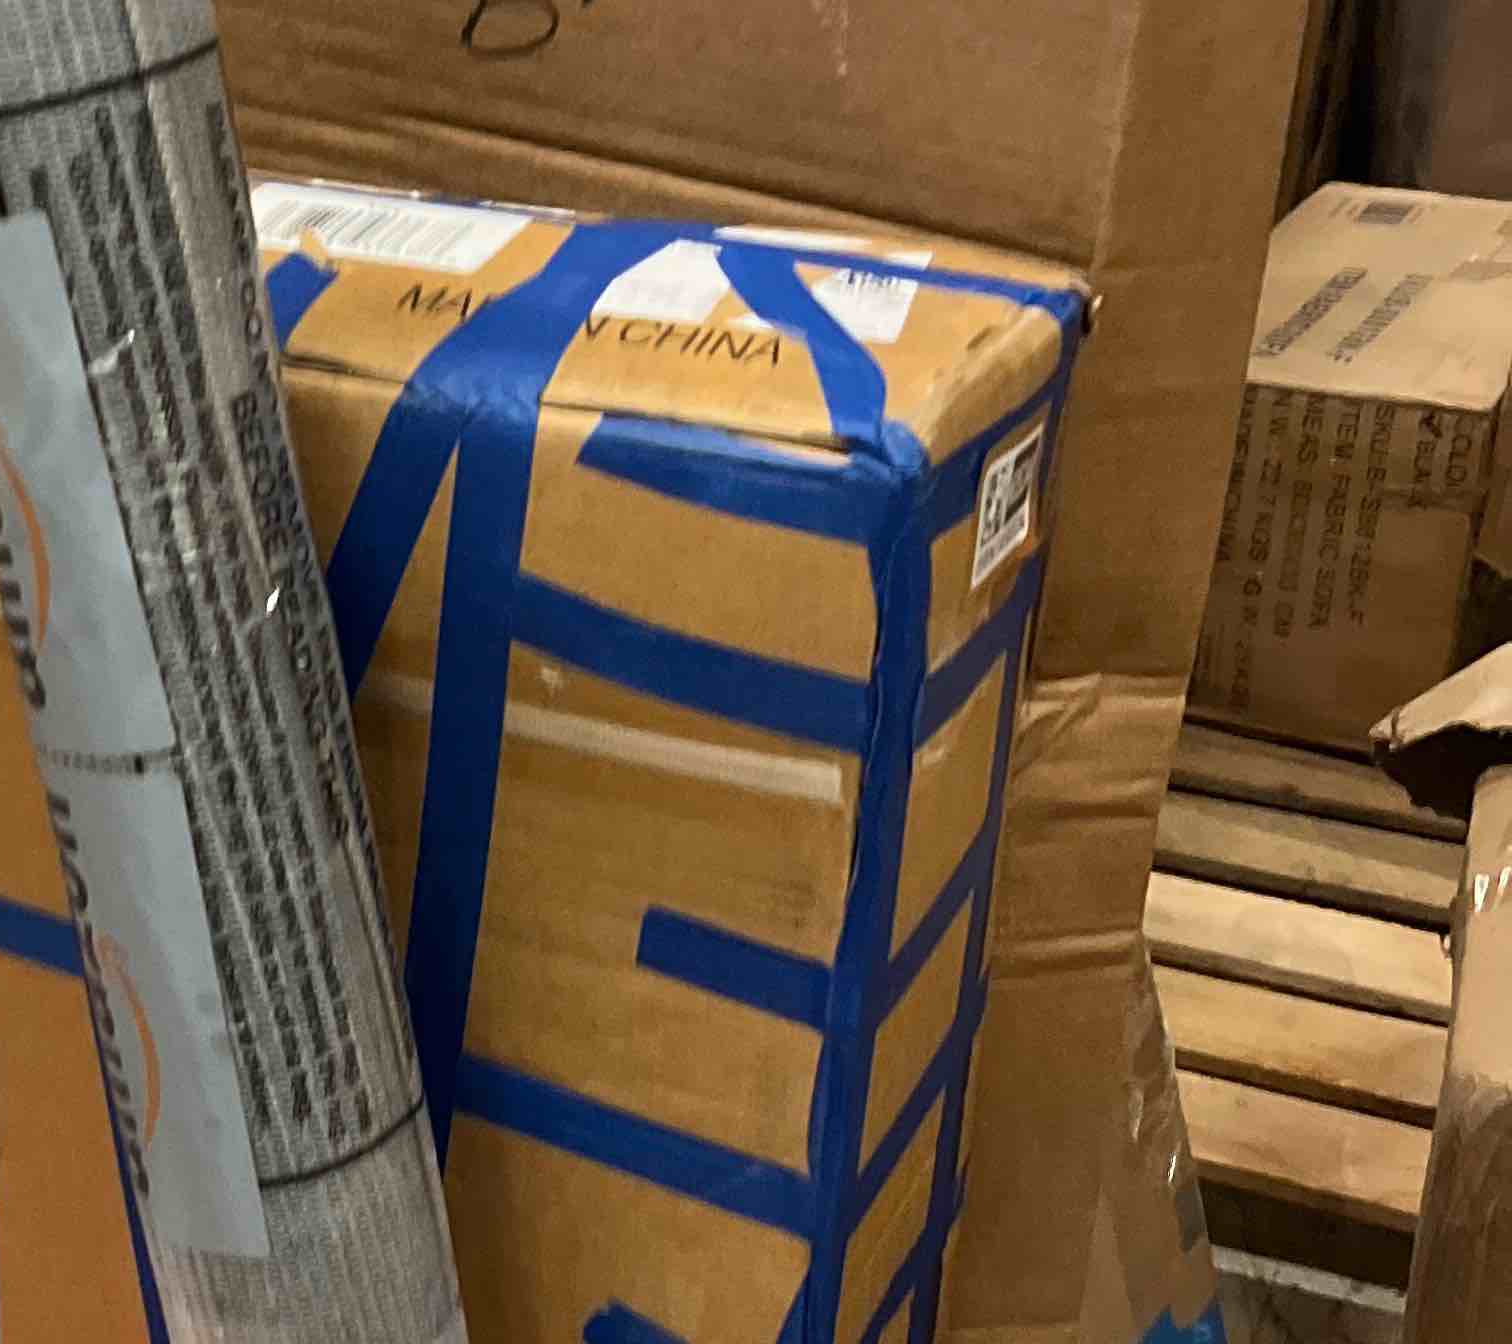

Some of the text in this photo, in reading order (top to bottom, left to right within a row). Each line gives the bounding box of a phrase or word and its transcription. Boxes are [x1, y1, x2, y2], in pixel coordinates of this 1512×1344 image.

[616, 318, 788, 368] CHINA
[229, 390, 288, 567] BEFORE
[1318, 471, 1353, 562] FABRIC
